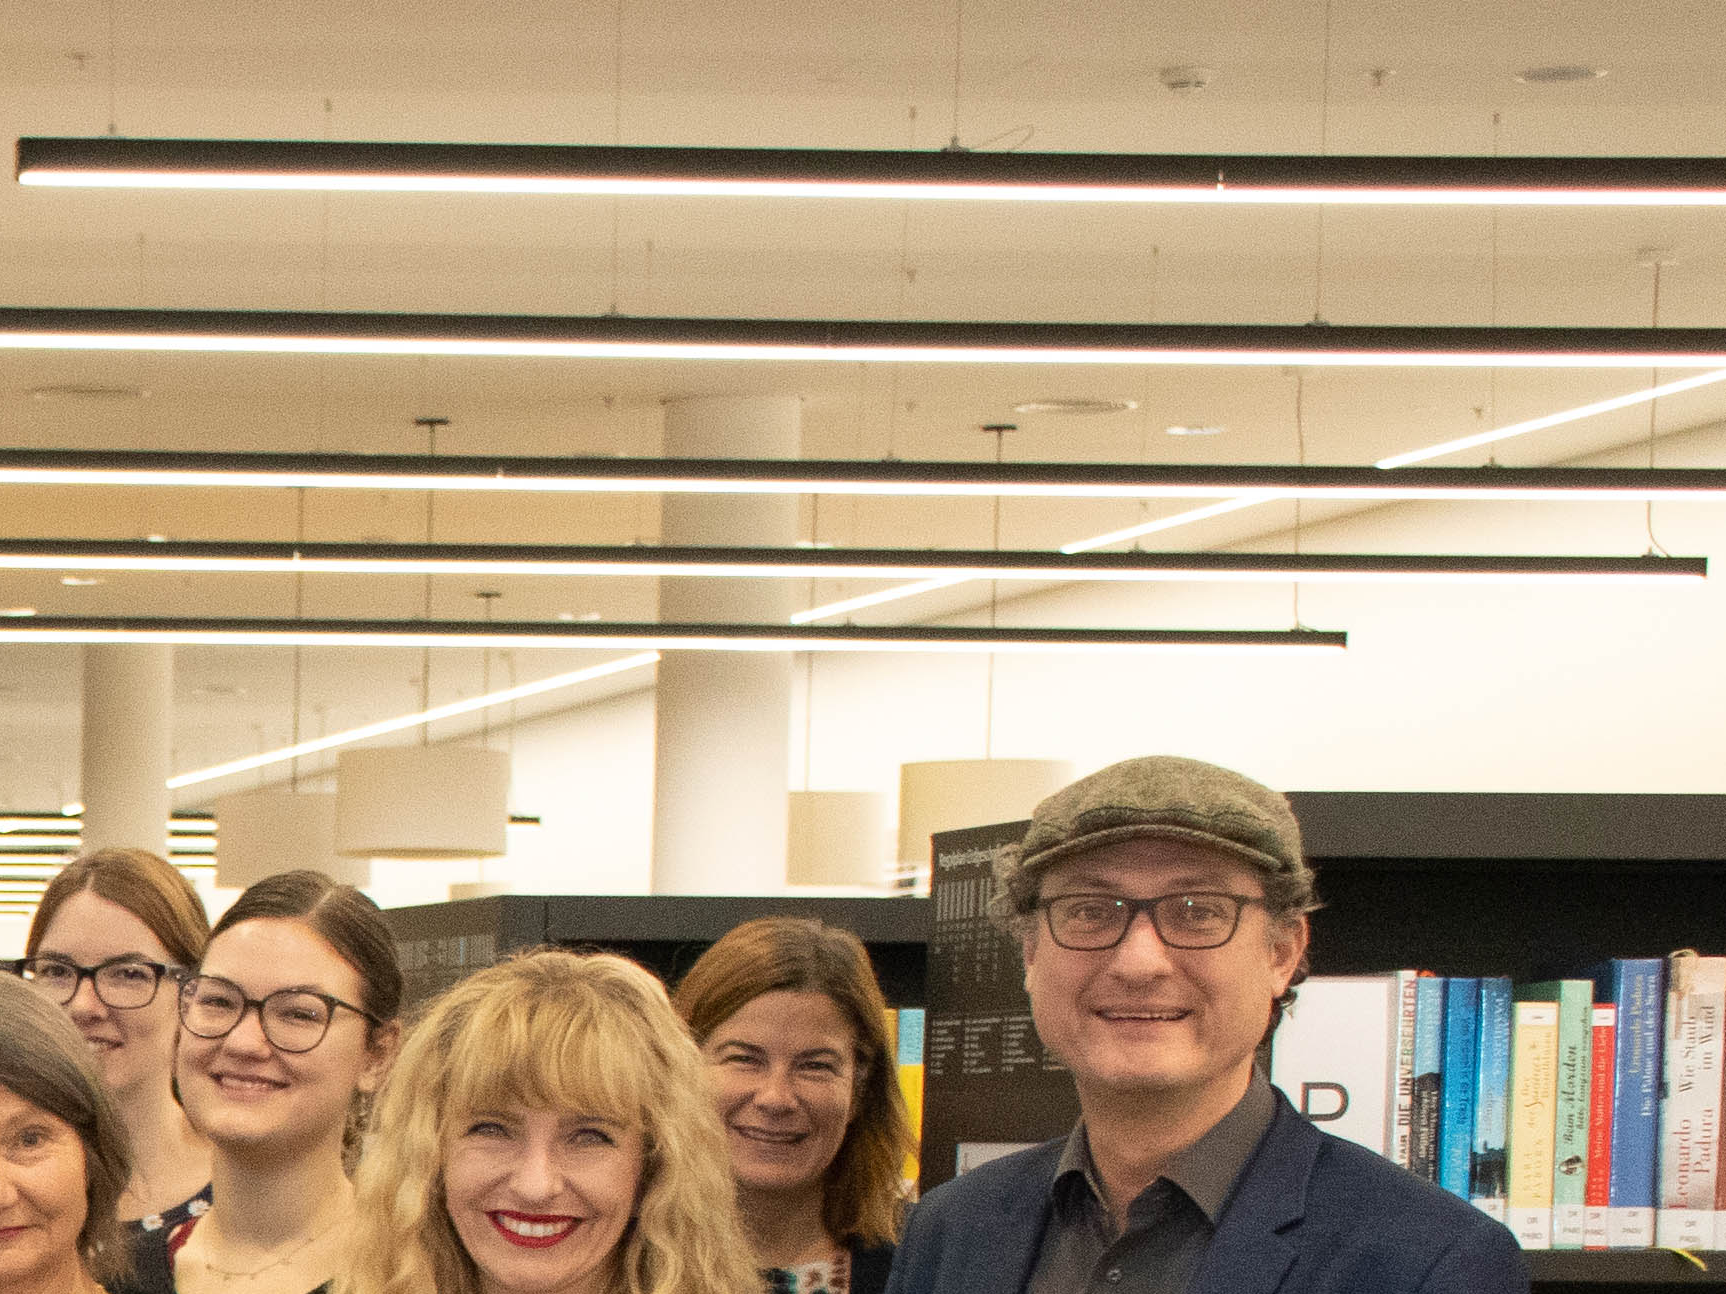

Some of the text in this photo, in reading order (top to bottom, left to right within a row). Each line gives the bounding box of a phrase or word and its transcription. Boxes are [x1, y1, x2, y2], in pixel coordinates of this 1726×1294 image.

[1399, 979, 1416, 1126] DIE UNVERSEHRTEN
[1669, 1119, 1692, 1209] Leonardo
[1694, 1109, 1714, 1173] Padura
